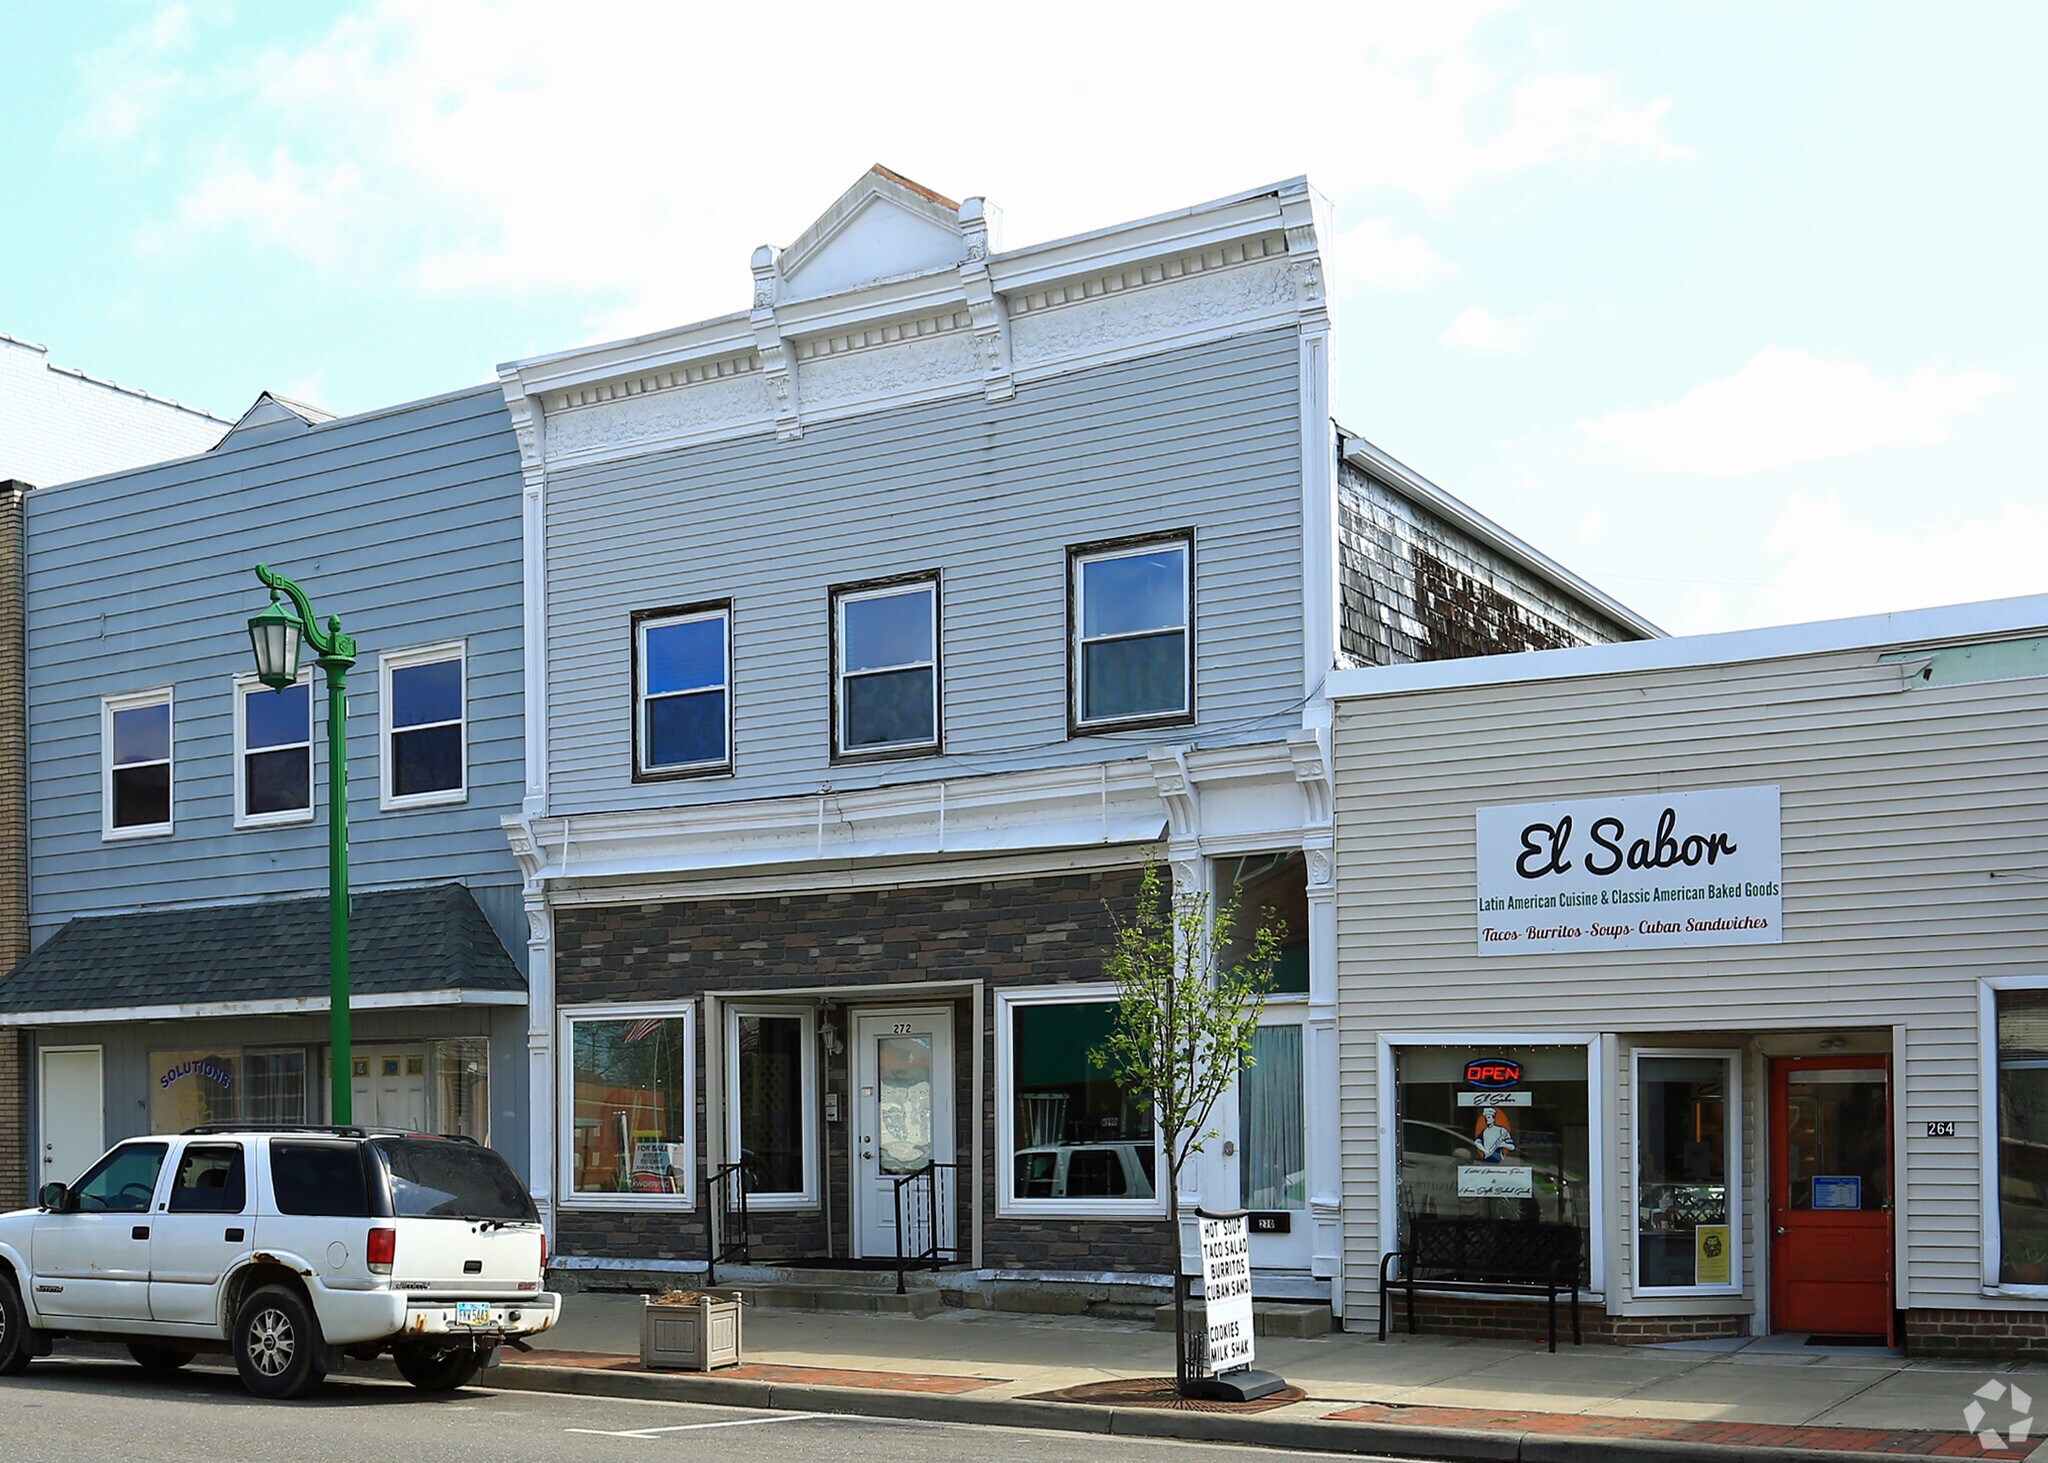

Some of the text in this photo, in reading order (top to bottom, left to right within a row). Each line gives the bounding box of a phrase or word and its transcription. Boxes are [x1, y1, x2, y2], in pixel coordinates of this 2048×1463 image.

[1516, 807, 1737, 879] El Sabor
[1479, 881, 1780, 912] Latin American Cuisine & Classic American Baked Goods
[1525, 924, 1582, 940] Burritos
[1638, 919, 1682, 935] Cuban
[1685, 915, 1768, 933] Sandwiches
[893, 1023, 912, 1034] 272
[160, 1060, 231, 1090] SOLUTIONS
[1467, 1066, 1519, 1080] OPEN
[1473, 1093, 1516, 1106] El Sabor
[1928, 1122, 1954, 1135] 264
[637, 1144, 650, 1152] FOR
[1204, 1218, 1241, 1239] HOT SOUP
[1203, 1238, 1247, 1260] TACO SALAD
[1210, 1258, 1245, 1280] BURRITOS
[1206, 1282, 1230, 1301] CUBAN
[1210, 1321, 1239, 1342] COOKIES
[1211, 1339, 1249, 1362] MILK SHAK
